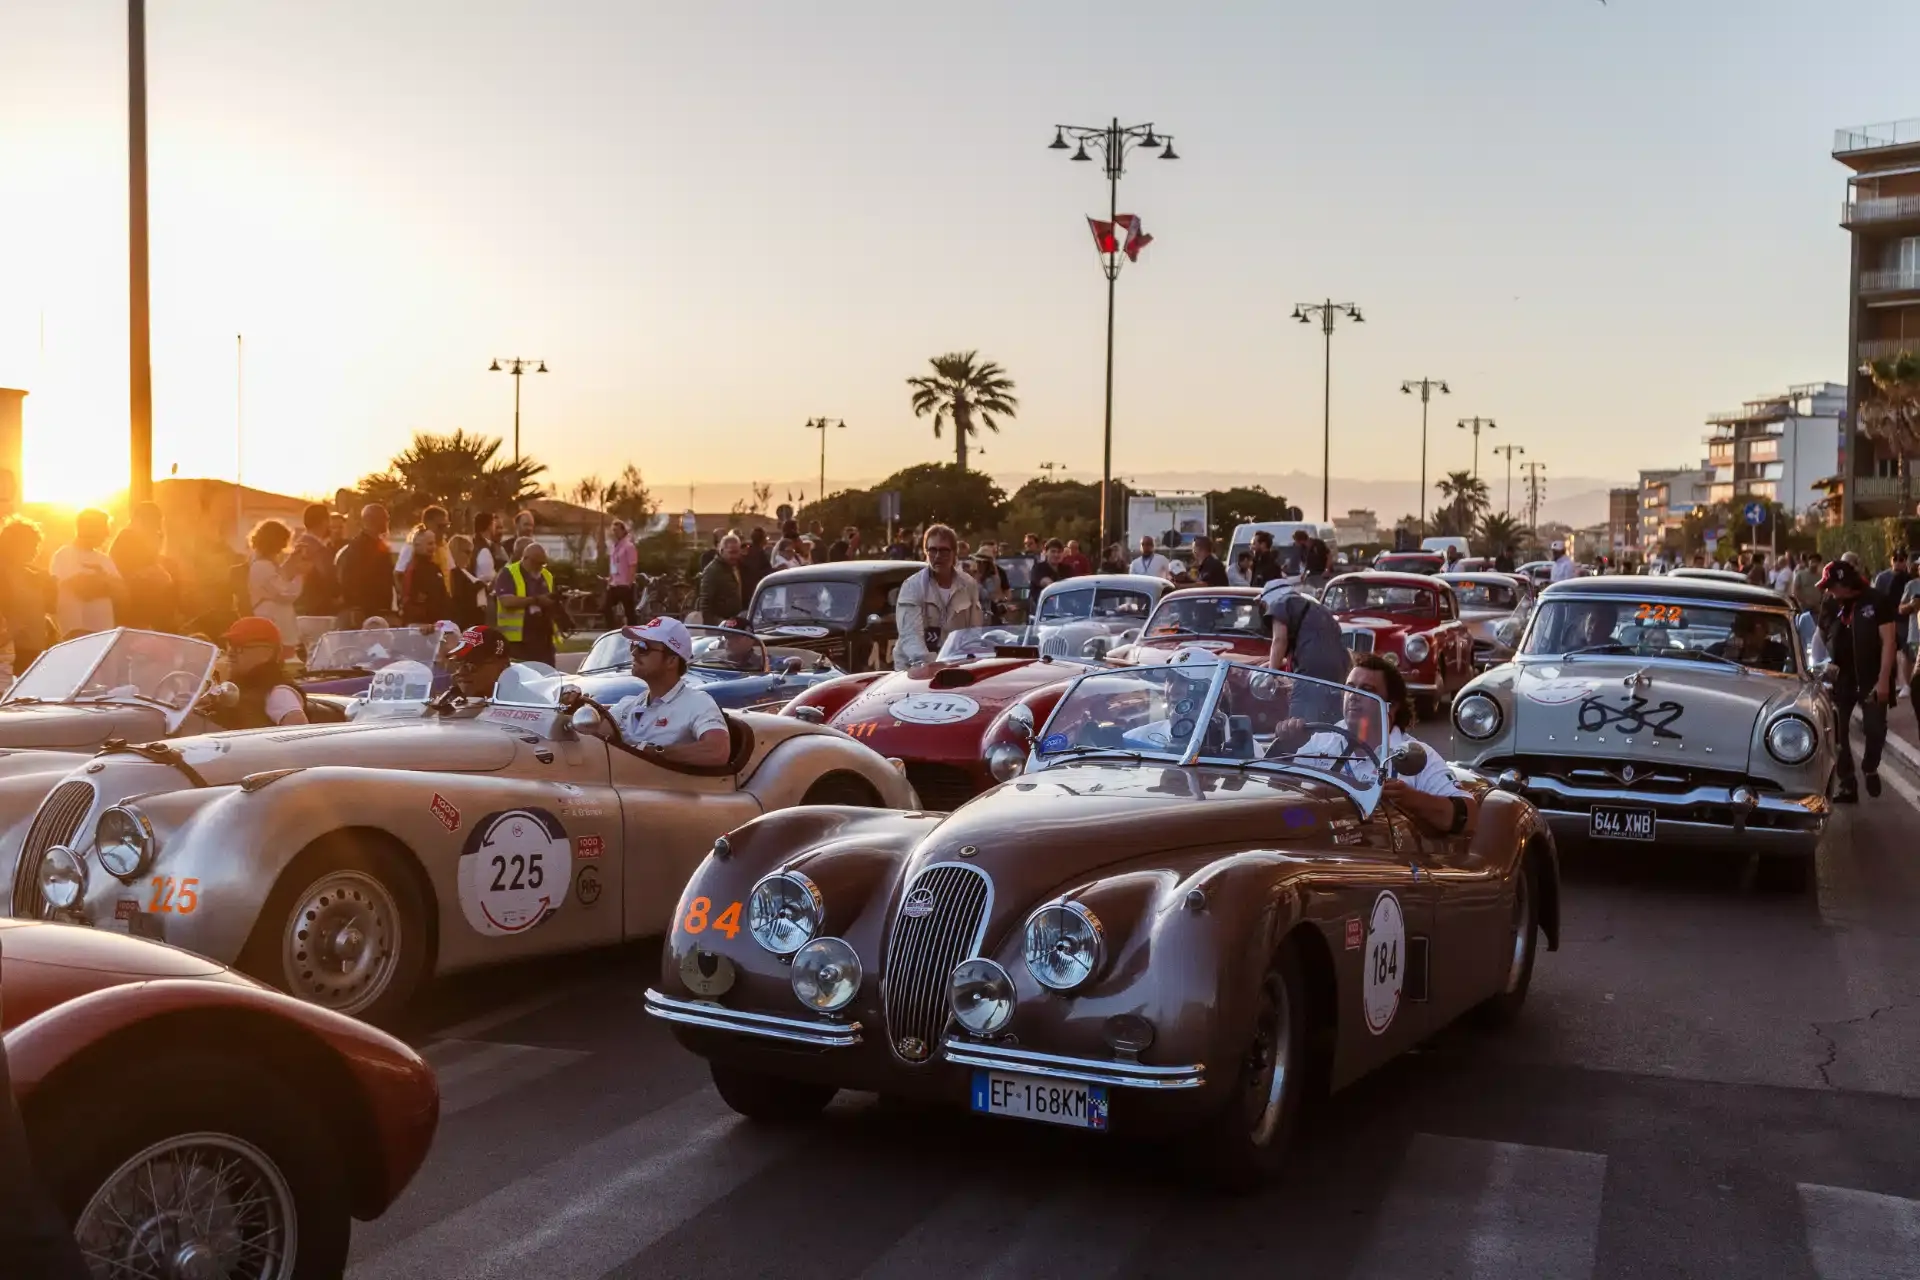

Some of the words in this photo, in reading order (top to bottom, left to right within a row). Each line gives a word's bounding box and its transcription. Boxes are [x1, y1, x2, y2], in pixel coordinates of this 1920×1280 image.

[1638, 603, 1682, 620] 222
[913, 701, 956, 712] 311
[1577, 694, 1684, 739] 632
[1595, 812, 1620, 831] 644
[1625, 814, 1651, 833] XWB
[579, 838, 598, 847] 1000
[490, 853, 543, 892] 225
[148, 876, 199, 915] 225
[1373, 940, 1397, 986] 184
[991, 1080, 1016, 1107] EF
[1025, 1084, 1087, 1118] 168KM
